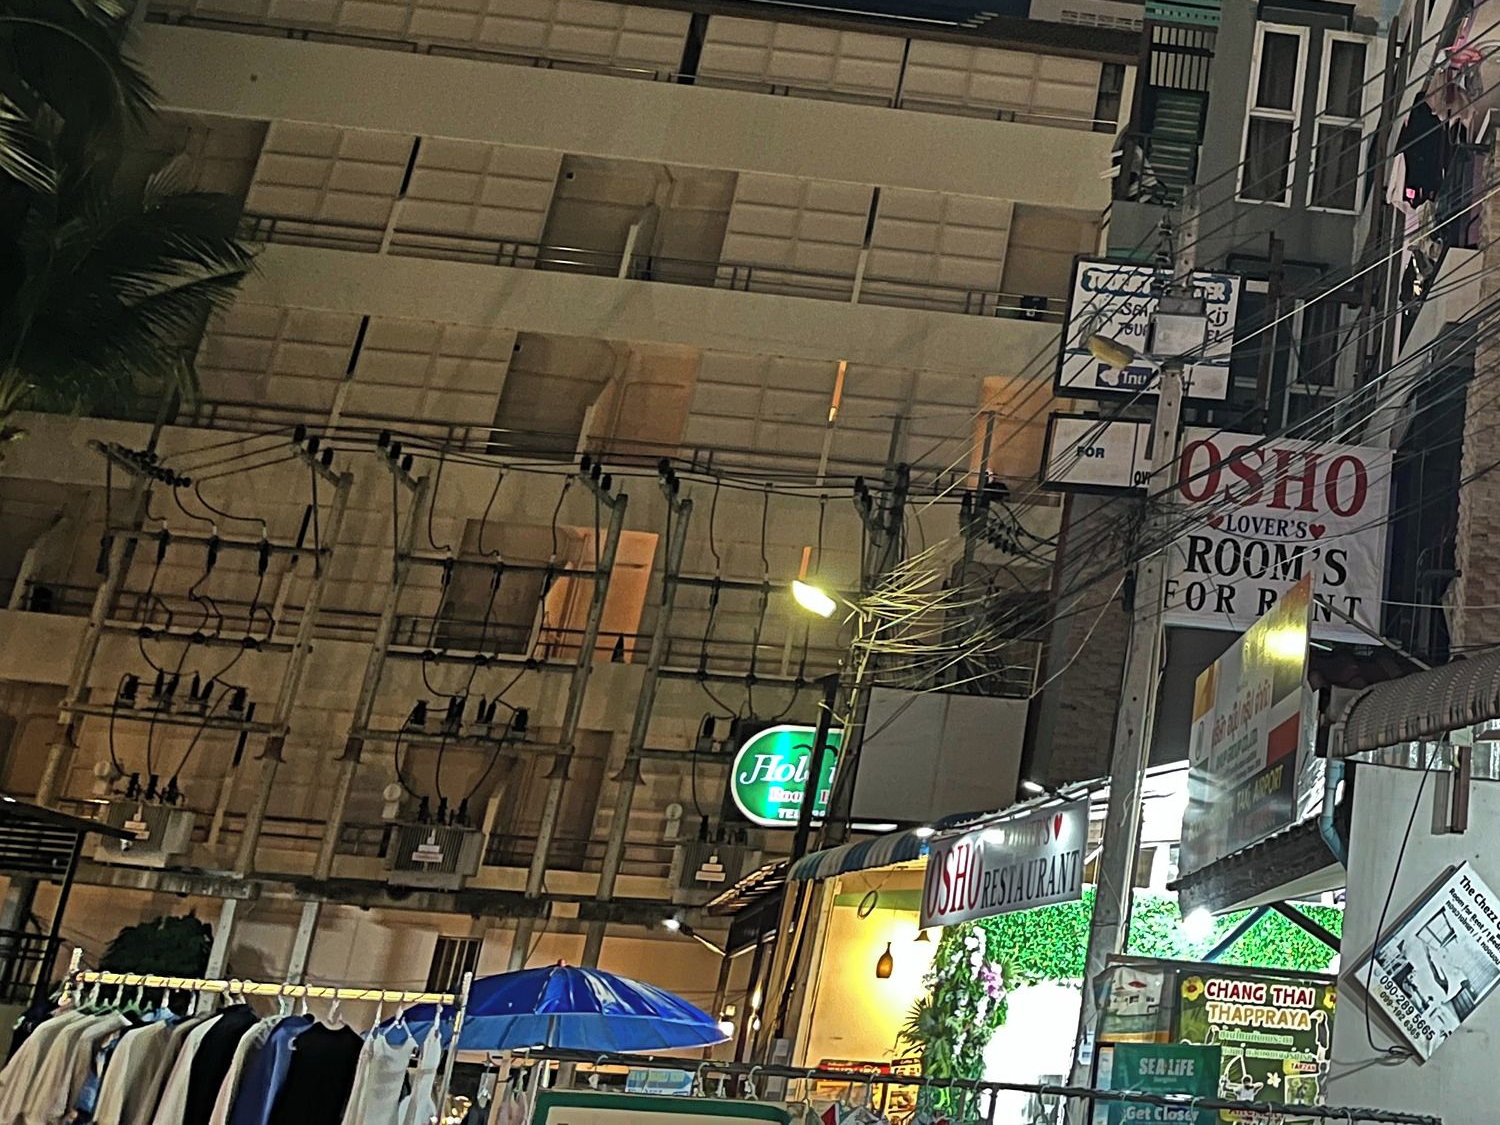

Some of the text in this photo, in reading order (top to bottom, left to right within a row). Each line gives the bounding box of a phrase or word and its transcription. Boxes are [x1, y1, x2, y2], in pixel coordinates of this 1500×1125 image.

[1076, 445, 1105, 459] FOR
[1178, 439, 1369, 518] OSHO
[1226, 513, 1308, 540] LOVER'S
[1184, 534, 1349, 587] ROOM'S
[1163, 579, 1363, 625] FOR RNT
[927, 840, 1081, 919] OSHO RESTAURANT
[1449, 887, 1465, 909] Room
[1461, 903, 1472, 917] for
[1471, 913, 1485, 931] Rent
[1459, 874, 1476, 896] The
[1474, 892, 1498, 924] Chezz
[1206, 981, 1316, 1006] CHANG THAI
[1208, 1003, 1311, 1029] THAPPRAYA
[1411, 1011, 1436, 1041] 5665
[1139, 1057, 1164, 1076] SEA
[1126, 1105, 1200, 1122] Get Closer
